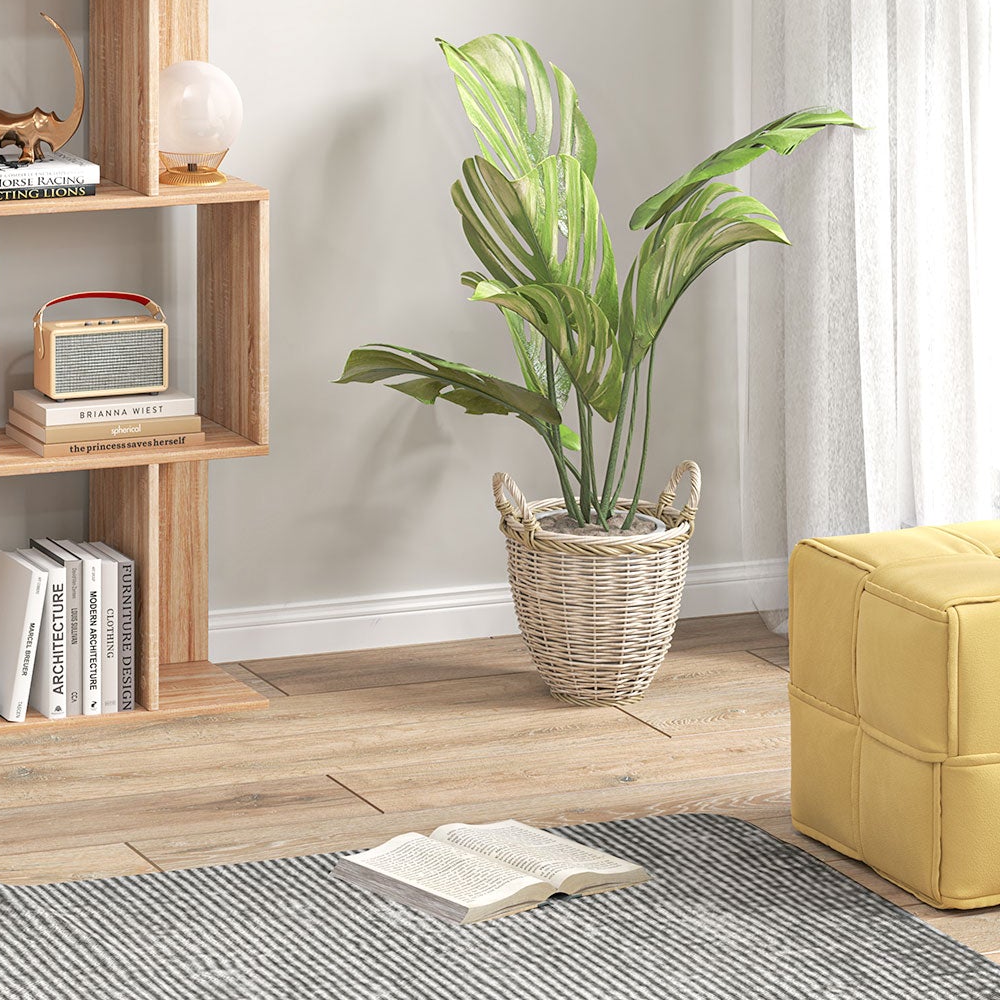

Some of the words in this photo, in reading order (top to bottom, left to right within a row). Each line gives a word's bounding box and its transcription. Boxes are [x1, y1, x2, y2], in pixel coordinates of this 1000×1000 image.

[37, 175, 85, 185] RACING
[44, 186, 86, 198] LIONS
[79, 408, 128, 419] BRIANNA
[133, 405, 164, 415] WIEST
[111, 424, 142, 436] spherical
[69, 444, 85, 453] the
[86, 441, 126, 454] princess
[126, 440, 152, 449] saves
[152, 436, 186, 447] herself
[89, 590, 98, 626] MODERN
[122, 564, 132, 652] FURNITURE
[25, 622, 36, 649] MARCEL
[52, 583, 64, 695] ARCHITECTURE
[106, 608, 114, 659] CLOTHING
[21, 650, 32, 676] BREUER
[89, 627, 98, 691] ARCHITECTURE
[122, 656, 132, 711] DESIGN
